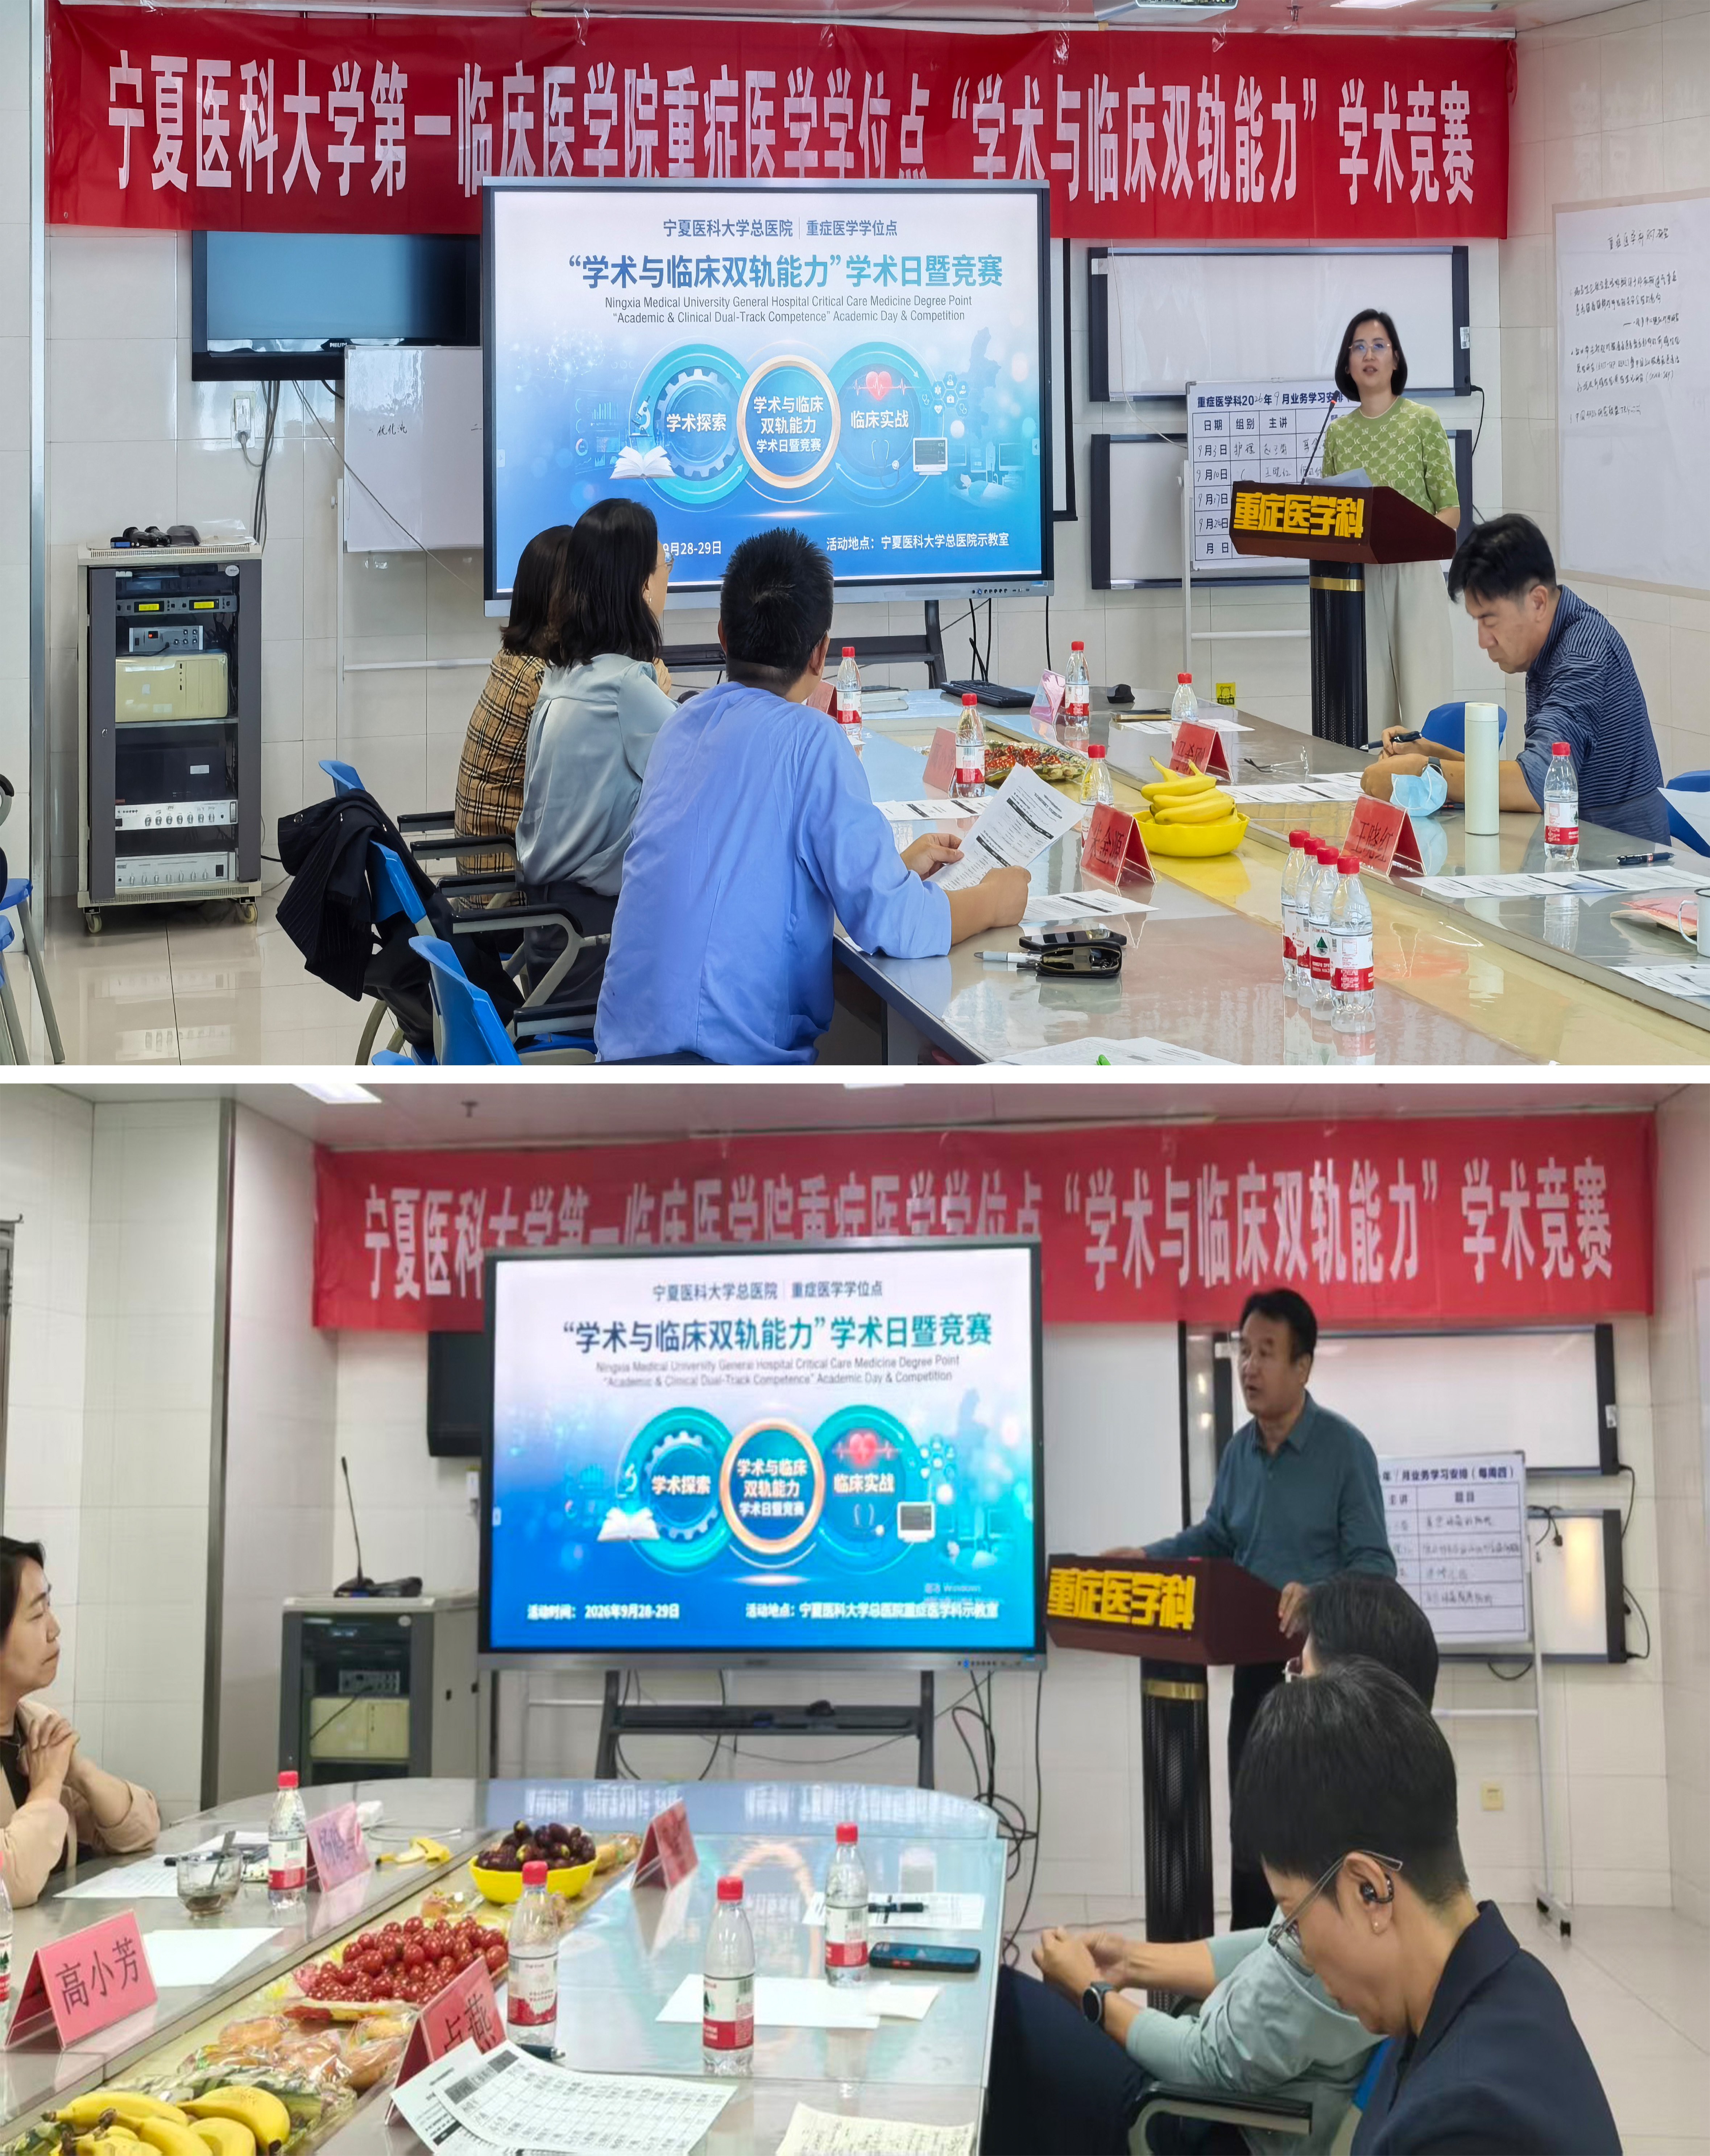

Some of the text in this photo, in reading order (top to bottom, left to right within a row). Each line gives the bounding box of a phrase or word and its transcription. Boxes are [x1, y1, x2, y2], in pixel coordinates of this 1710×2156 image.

[1338, 78, 1474, 204] 学术竞赛
[663, 219, 898, 237] 宁夏医科大学总医院 重症医学学位点
[605, 295, 972, 310] Ningxia Medical University General Hospital Critical Care Medicine Degree Point
[667, 312, 674, 323] &
[678, 312, 711, 323] Clinical
[715, 311, 765, 322] Dual-Track
[833, 311, 878, 321] Academic
[881, 311, 898, 323] Day
[901, 311, 907, 321] &
[911, 310, 965, 323] Competition
[753, 396, 824, 414] 学术与临床
[666, 413, 726, 432] 学术探索
[761, 416, 816, 435] 双轨能力
[850, 410, 909, 429] 临床实战
[1204, 419, 1222, 431] 日期
[1236, 418, 1255, 430] 组别
[1269, 416, 1287, 428] 主讲
[756, 438, 821, 453] 学术日暨竞赛
[1233, 492, 1365, 539] 重症医学科
[1461, 1157, 1612, 1284] 学术竞赛
[653, 1281, 882, 1301] 宁夏医科大学总医院 重症医学学位点
[737, 1458, 807, 1476] 学术与临床
[652, 1475, 711, 1495] 学术探索
[744, 1480, 800, 1498] 双轨能力
[834, 1473, 895, 1493] 临床实战
[1047, 1567, 1196, 1630] 重症医学科
[55, 1937, 139, 2015] 高小芳
